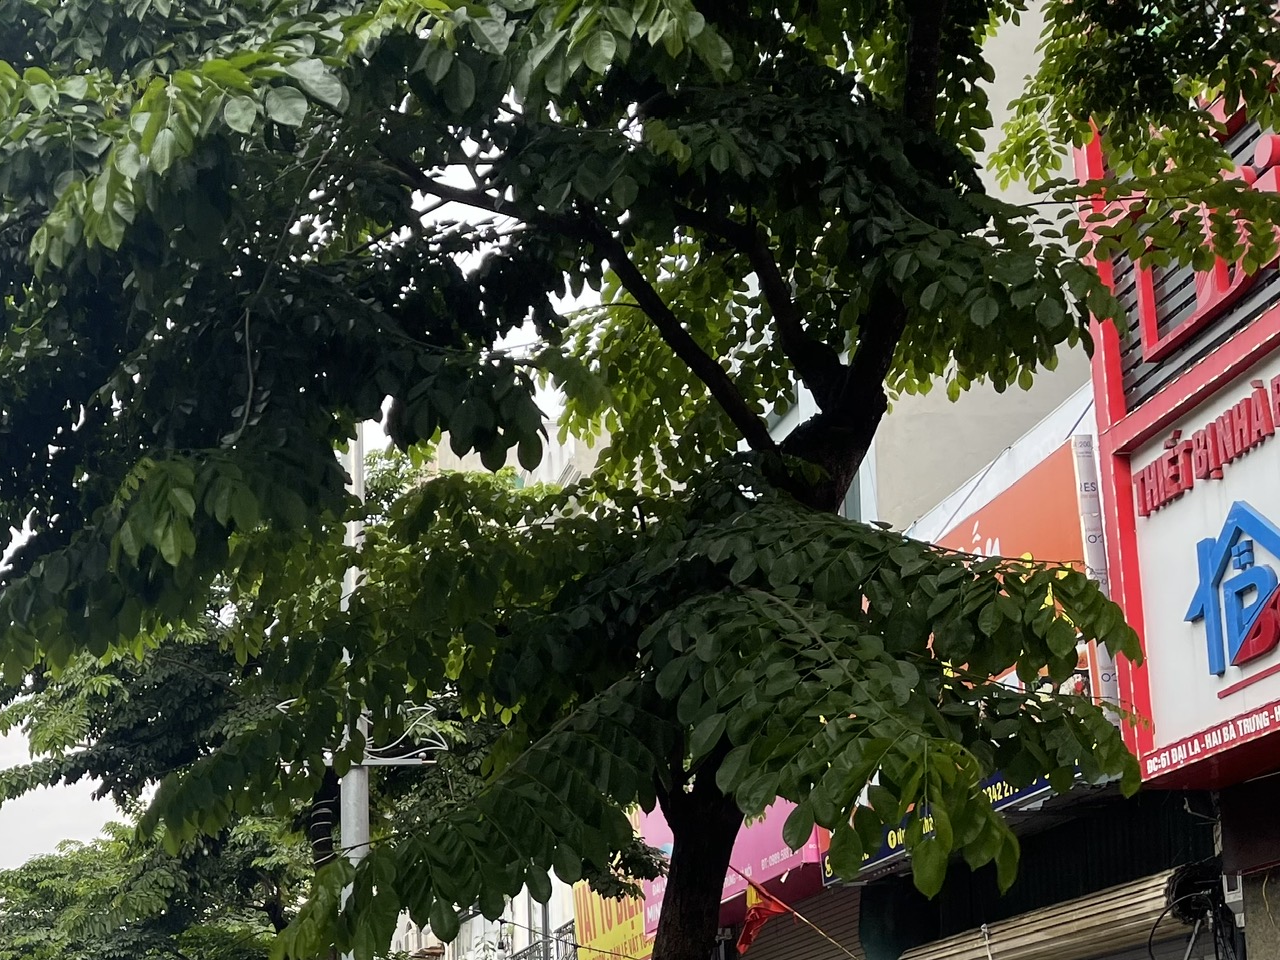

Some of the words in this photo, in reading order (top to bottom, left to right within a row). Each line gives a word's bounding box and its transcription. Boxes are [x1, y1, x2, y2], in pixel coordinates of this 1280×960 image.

[1133, 430, 1194, 517] THIẾT
[1192, 423, 1224, 480] BỊ
[1215, 379, 1275, 464] NHÀ
[1170, 744, 1187, 764] ĐẠI
[1188, 738, 1201, 756] LA
[1204, 730, 1222, 749] HAI
[1222, 721, 1236, 742] BÀ
[1237, 711, 1270, 736] TRƯNG
